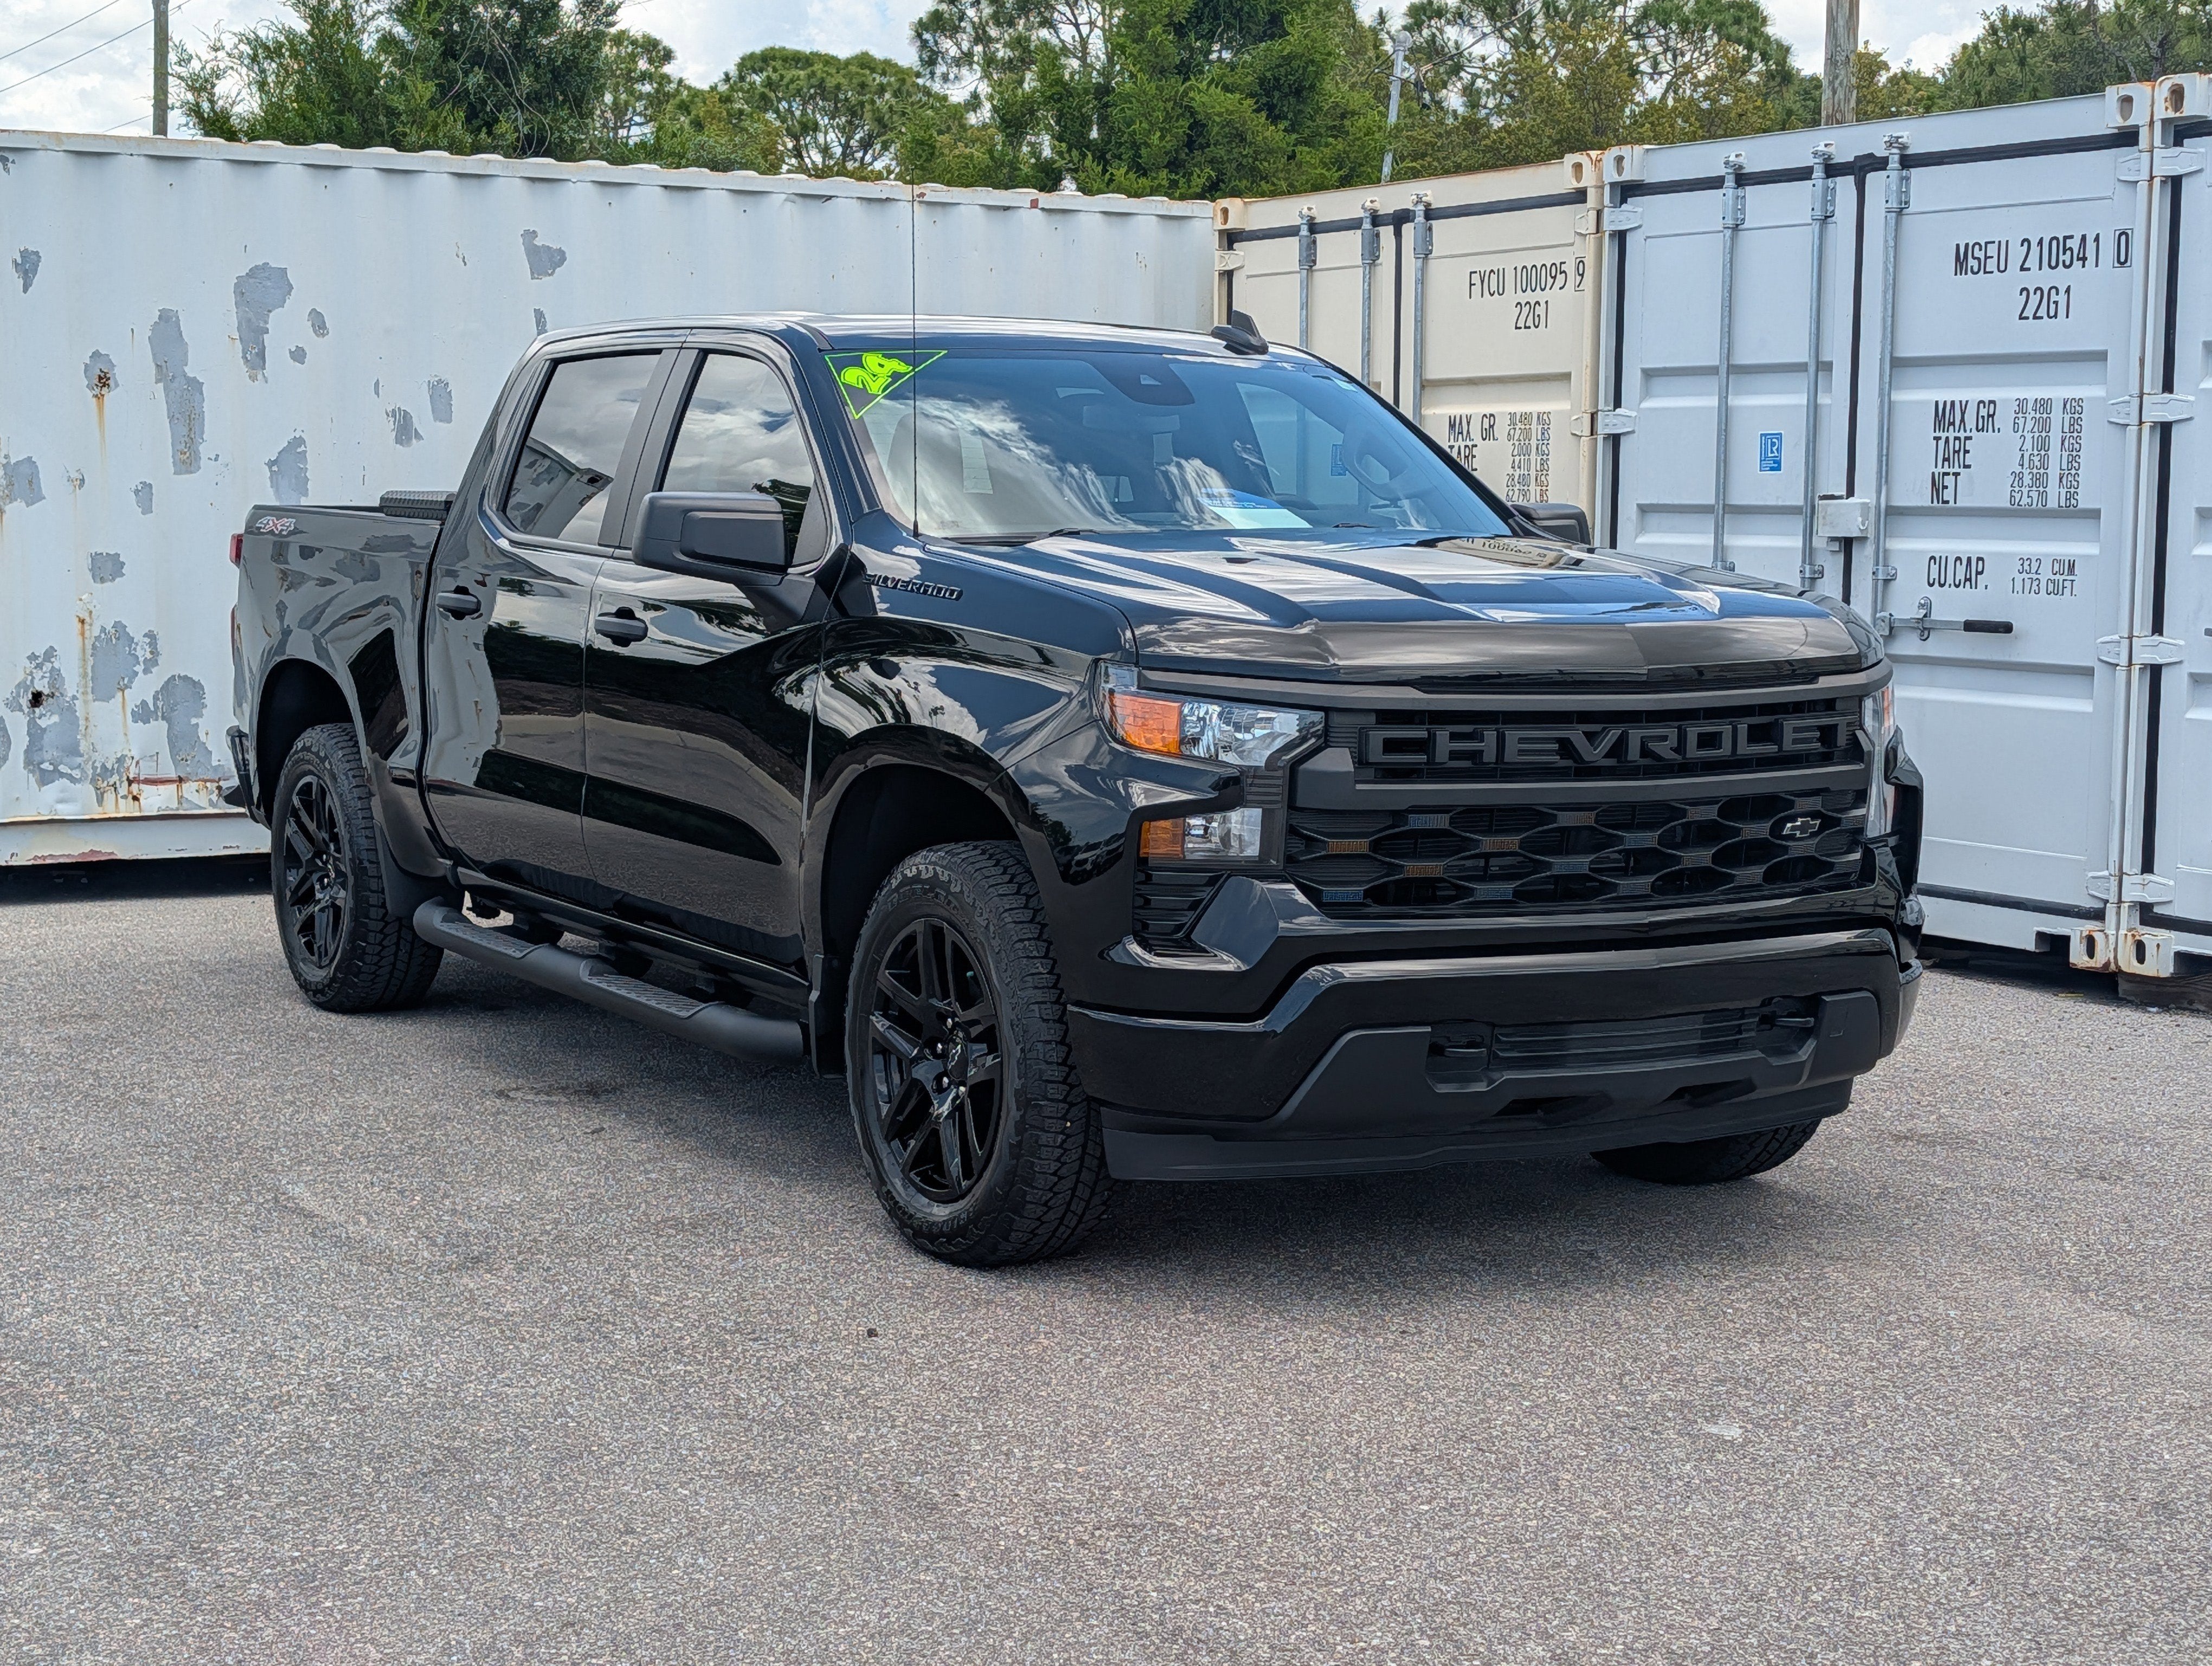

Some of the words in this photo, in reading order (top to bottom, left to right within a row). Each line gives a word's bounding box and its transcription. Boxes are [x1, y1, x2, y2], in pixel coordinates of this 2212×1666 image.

[1954, 240, 2009, 276] MSEU
[2020, 233, 2100, 272] 210541
[2116, 230, 2130, 266] 0
[1469, 267, 1506, 299] FYCU
[1513, 261, 1567, 294] 100095
[1576, 260, 1585, 288] 9
[2018, 285, 2071, 320] 22G1
[1515, 300, 1548, 330] 22G1
[2014, 398, 2053, 415] 30.480
[2062, 398, 2084, 415] KGS
[1536, 412, 1551, 426] KGS
[2013, 416, 2052, 433] 67.200
[2061, 416, 2083, 433] LBS
[1448, 414, 1474, 443] MAX.
[1536, 427, 1551, 441] LBS
[1535, 443, 1550, 457] KGS
[2018, 434, 2050, 452] 2.100
[2060, 435, 2082, 452] KGS
[1933, 436, 1973, 469] TARE
[1535, 458, 1549, 472] LBS
[2018, 453, 2049, 470] 4.630
[2060, 454, 2081, 471] LBS
[1535, 473, 1549, 488] KGS
[1930, 471, 1960, 504] NET
[2010, 471, 2048, 489] 28.380
[2059, 472, 2080, 489] KGS
[1535, 489, 1548, 503] LBS
[2009, 490, 2048, 507] 62.570
[2058, 491, 2079, 508] LBS
[1927, 555, 1988, 589] CU.CAP.
[2011, 577, 2040, 595] 1.173
[1359, 713, 1860, 765] CHEVROLET
